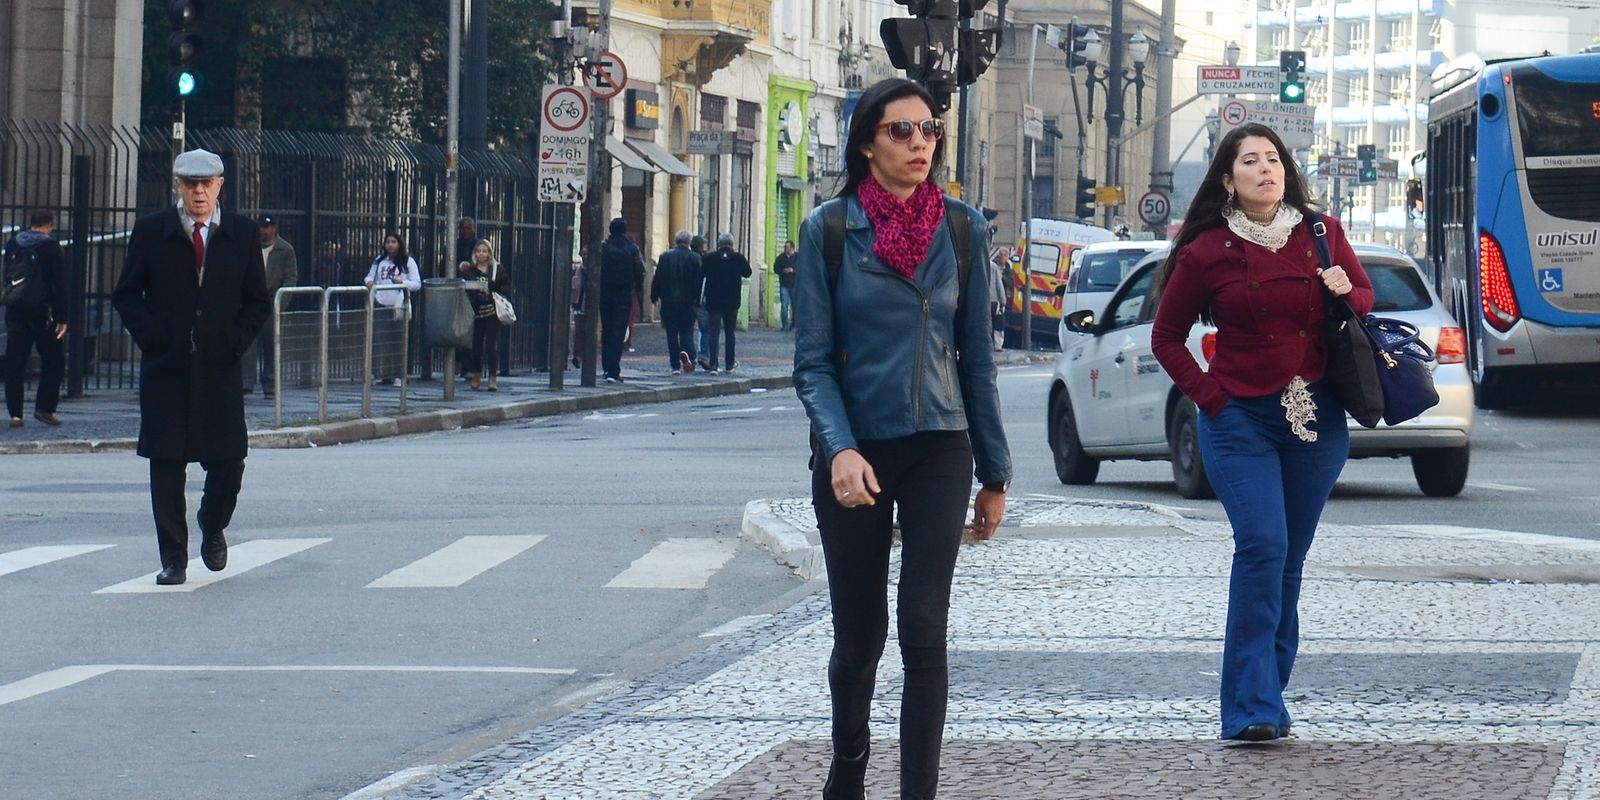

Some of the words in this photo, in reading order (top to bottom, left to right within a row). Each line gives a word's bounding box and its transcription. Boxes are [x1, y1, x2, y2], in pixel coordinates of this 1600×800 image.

[1205, 69, 1237, 78] NUNCA
[1246, 70, 1275, 79] FECHE
[1213, 81, 1275, 89] CRUZAMENTO
[1255, 102, 1268, 111] SÓ
[1273, 102, 1308, 115] ÔNIBUS
[542, 135, 587, 145] DOMINGO
[547, 147, 582, 160] 7-16h
[1543, 157, 1572, 167] Disque
[1144, 199, 1166, 215] 50
[1039, 228, 1061, 237] 7372
[1537, 228, 1598, 248] unisul
